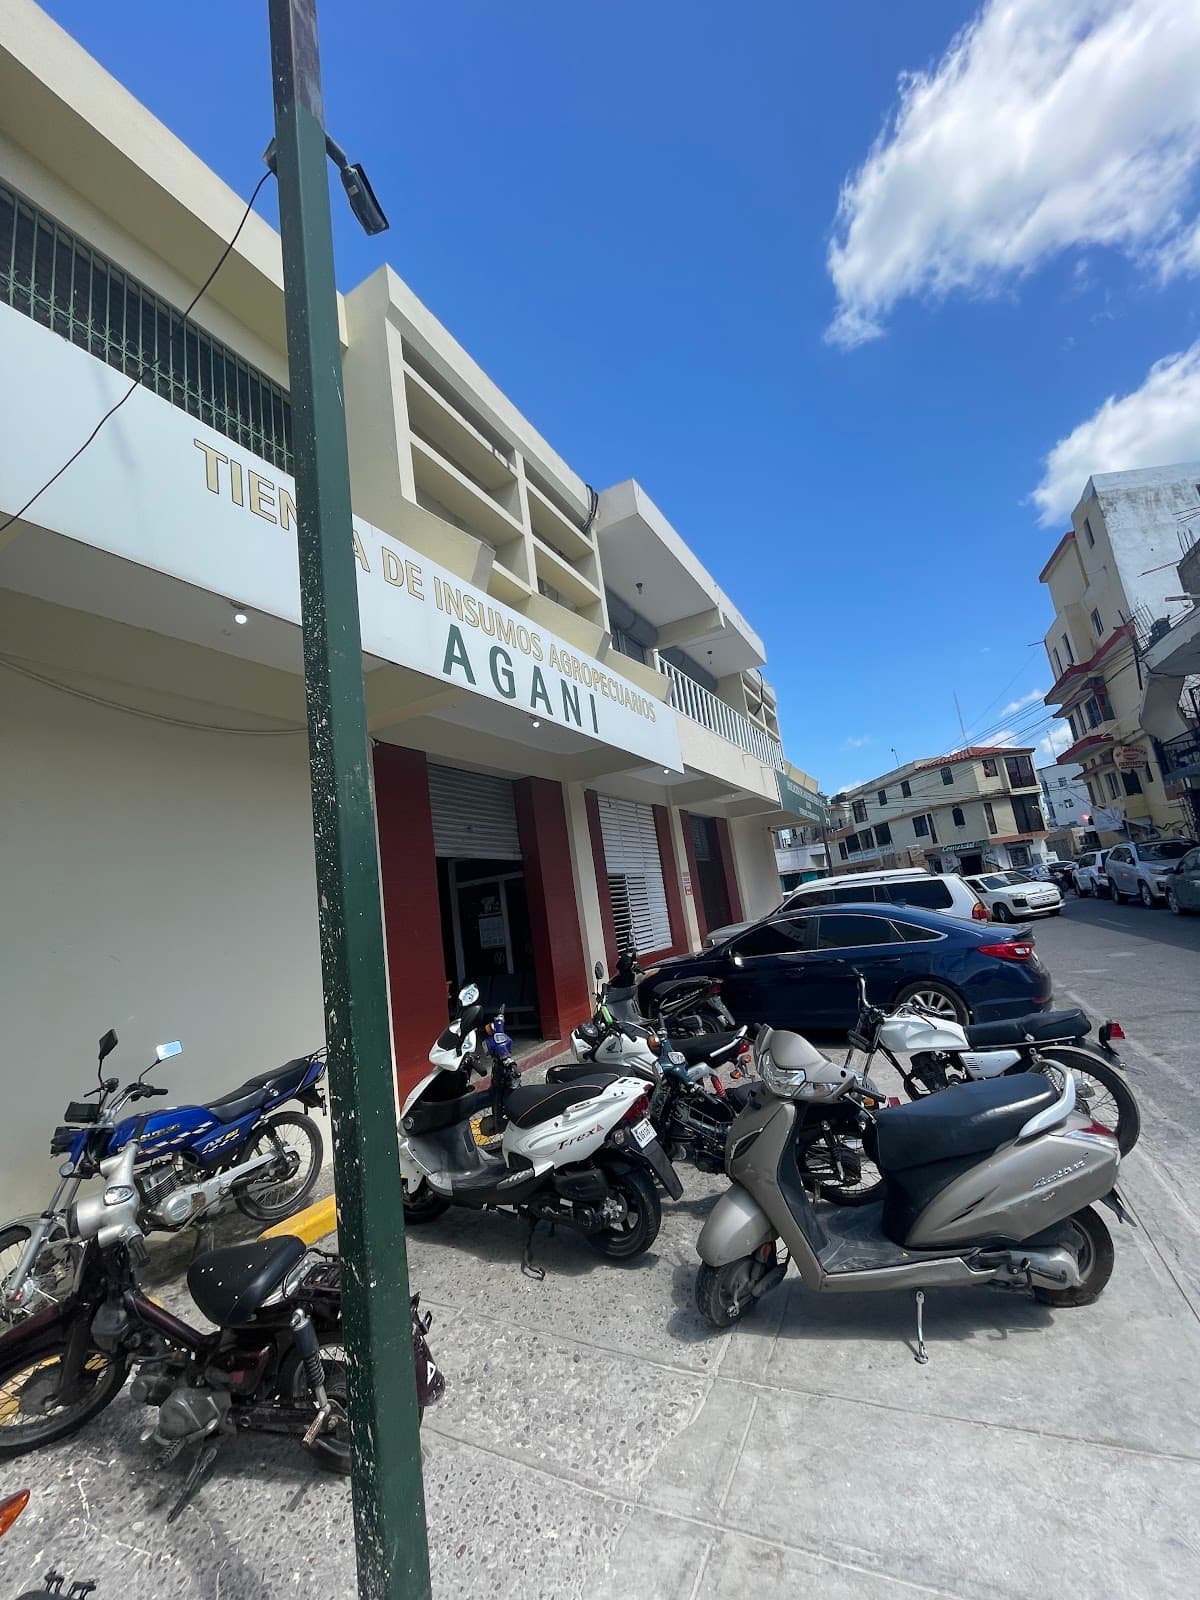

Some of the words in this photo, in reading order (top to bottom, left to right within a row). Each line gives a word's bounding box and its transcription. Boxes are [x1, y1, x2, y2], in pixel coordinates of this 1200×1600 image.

[194, 438, 371, 573] TIENA
[382, 546, 424, 601] DE
[434, 576, 543, 661] INSUMOS
[550, 644, 657, 723] AGROPECUARIOS
[442, 623, 599, 735] AGANI
